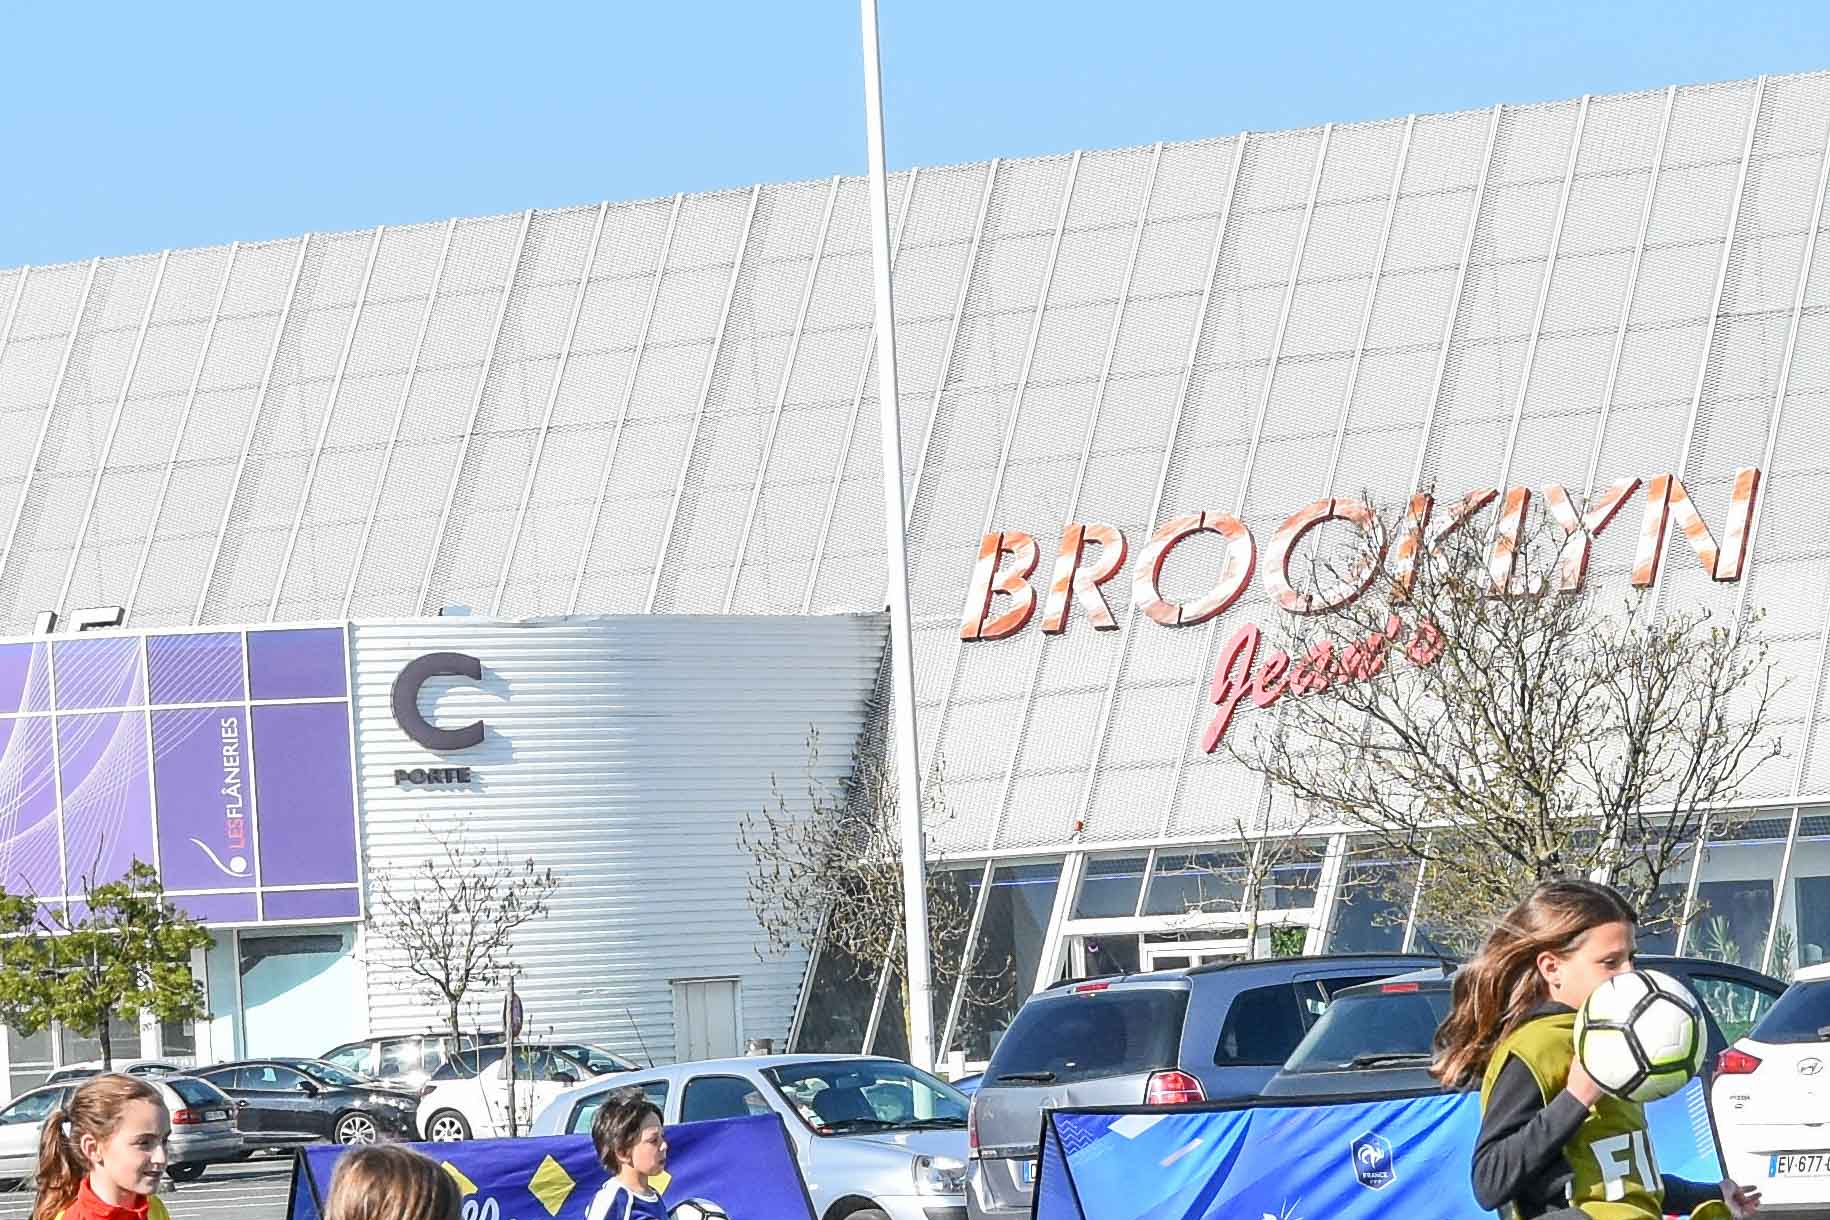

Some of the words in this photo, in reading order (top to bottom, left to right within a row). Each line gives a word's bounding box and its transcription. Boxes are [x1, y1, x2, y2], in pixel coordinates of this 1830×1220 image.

[959, 466, 1762, 642] BROOKLYN
[390, 652, 485, 750] C
[394, 767, 472, 786] PORTE
